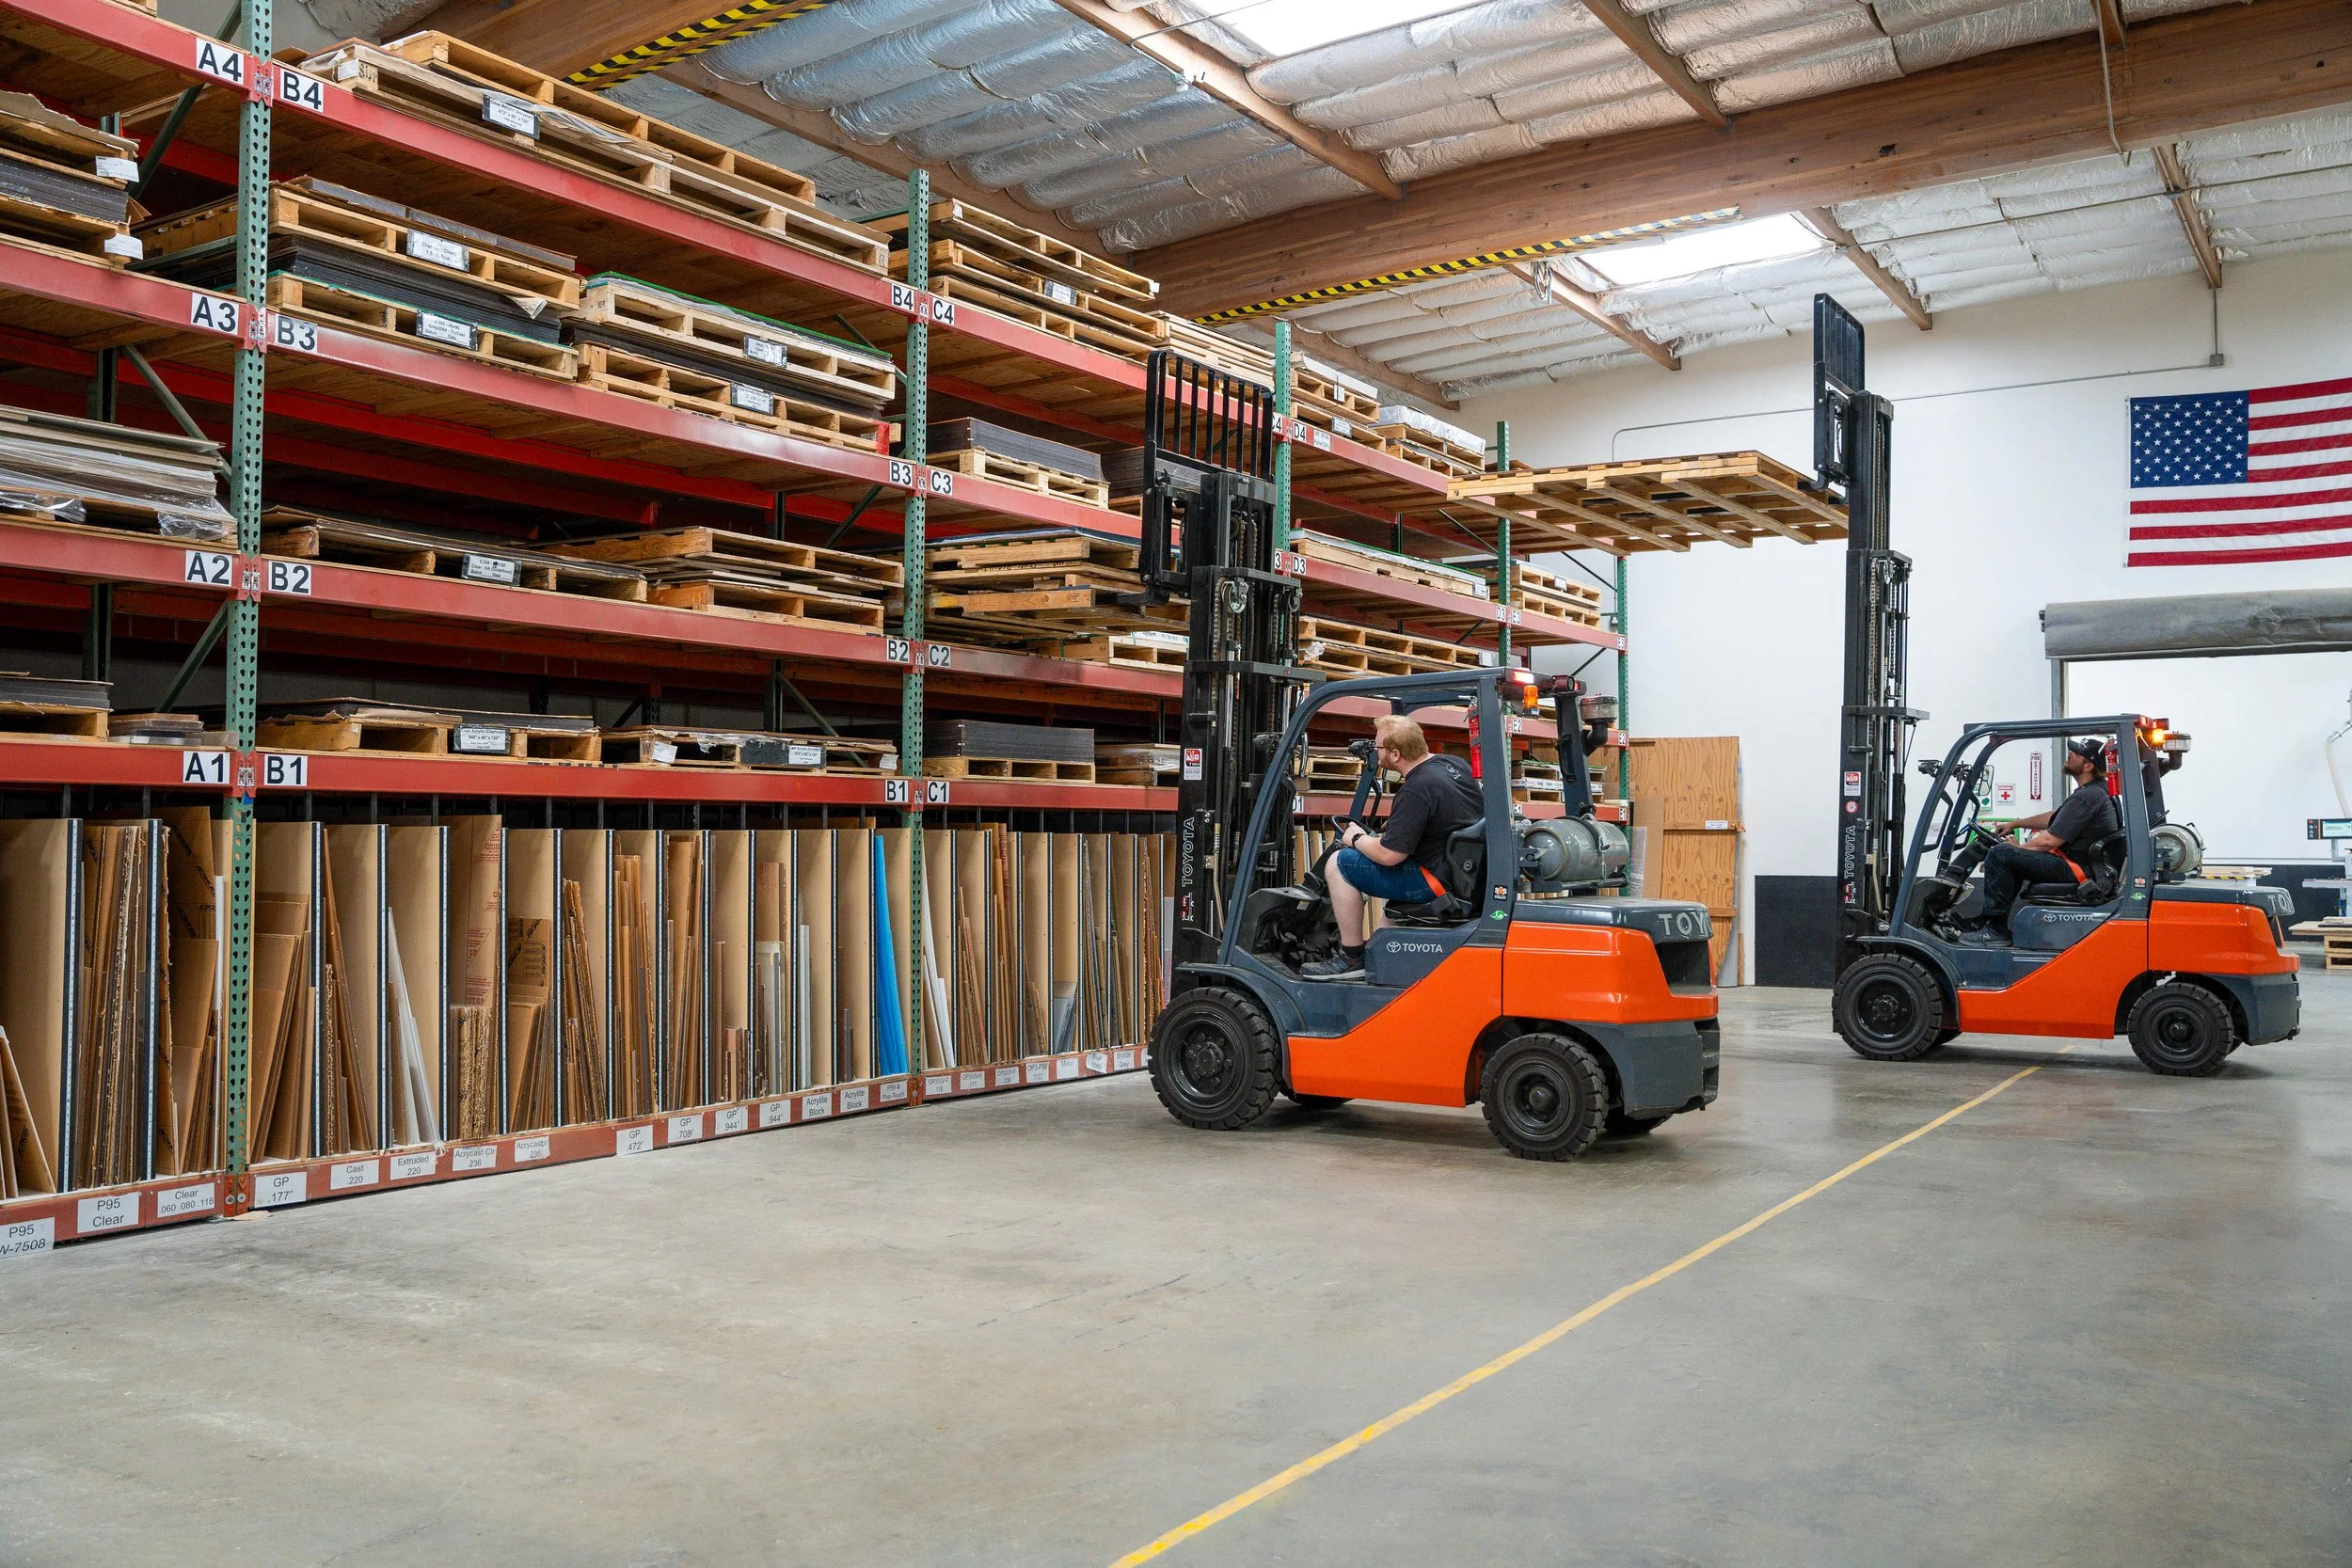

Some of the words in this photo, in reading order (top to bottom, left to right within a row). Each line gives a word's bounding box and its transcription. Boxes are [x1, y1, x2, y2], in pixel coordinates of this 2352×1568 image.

[199, 42, 241, 82] A4
[283, 71, 322, 110] B4
[893, 285, 914, 310] B4
[192, 296, 236, 332] A3
[933, 300, 954, 324] C4
[278, 316, 316, 351] B3
[1294, 422, 1305, 441] D4
[891, 462, 912, 485] B3
[931, 471, 951, 495] C3
[186, 552, 230, 585] A2
[1294, 556, 1305, 574] D3
[271, 562, 310, 594] B2
[888, 640, 909, 662] B2
[930, 645, 950, 666] C2
[1513, 719, 1521, 732] E2
[184, 752, 224, 783] A1
[266, 755, 302, 785] B1
[886, 781, 905, 801] B1
[928, 782, 946, 802] C1
[1182, 816, 1195, 888] TOYOTA
[1844, 825, 1855, 879] TOYOTA
[1402, 942, 1443, 954] TOYOTA
[805, 1097, 828, 1106] Acrylite
[844, 1089, 866, 1100] Acrylite
[882, 1091, 906, 1100] Pop-Touch
[847, 1101, 863, 1109] Block
[679, 1117, 691, 1127] GP
[726, 1111, 737, 1119] GP
[628, 1130, 641, 1139] GP
[397, 1155, 429, 1166] Extruded
[454, 1148, 484, 1159] Acrycast
[484, 1147, 496, 1156] Clr
[346, 1164, 364, 1174] Cast
[273, 1177, 290, 1188] GP
[346, 1176, 364, 1186] .220
[175, 1189, 199, 1200] Clear
[97, 1198, 120, 1211] P95
[159, 1204, 177, 1213] .060
[179, 1201, 196, 1211] .080
[198, 1197, 215, 1208] .118
[92, 1213, 124, 1227] Clear
[8, 1224, 35, 1238] P95
